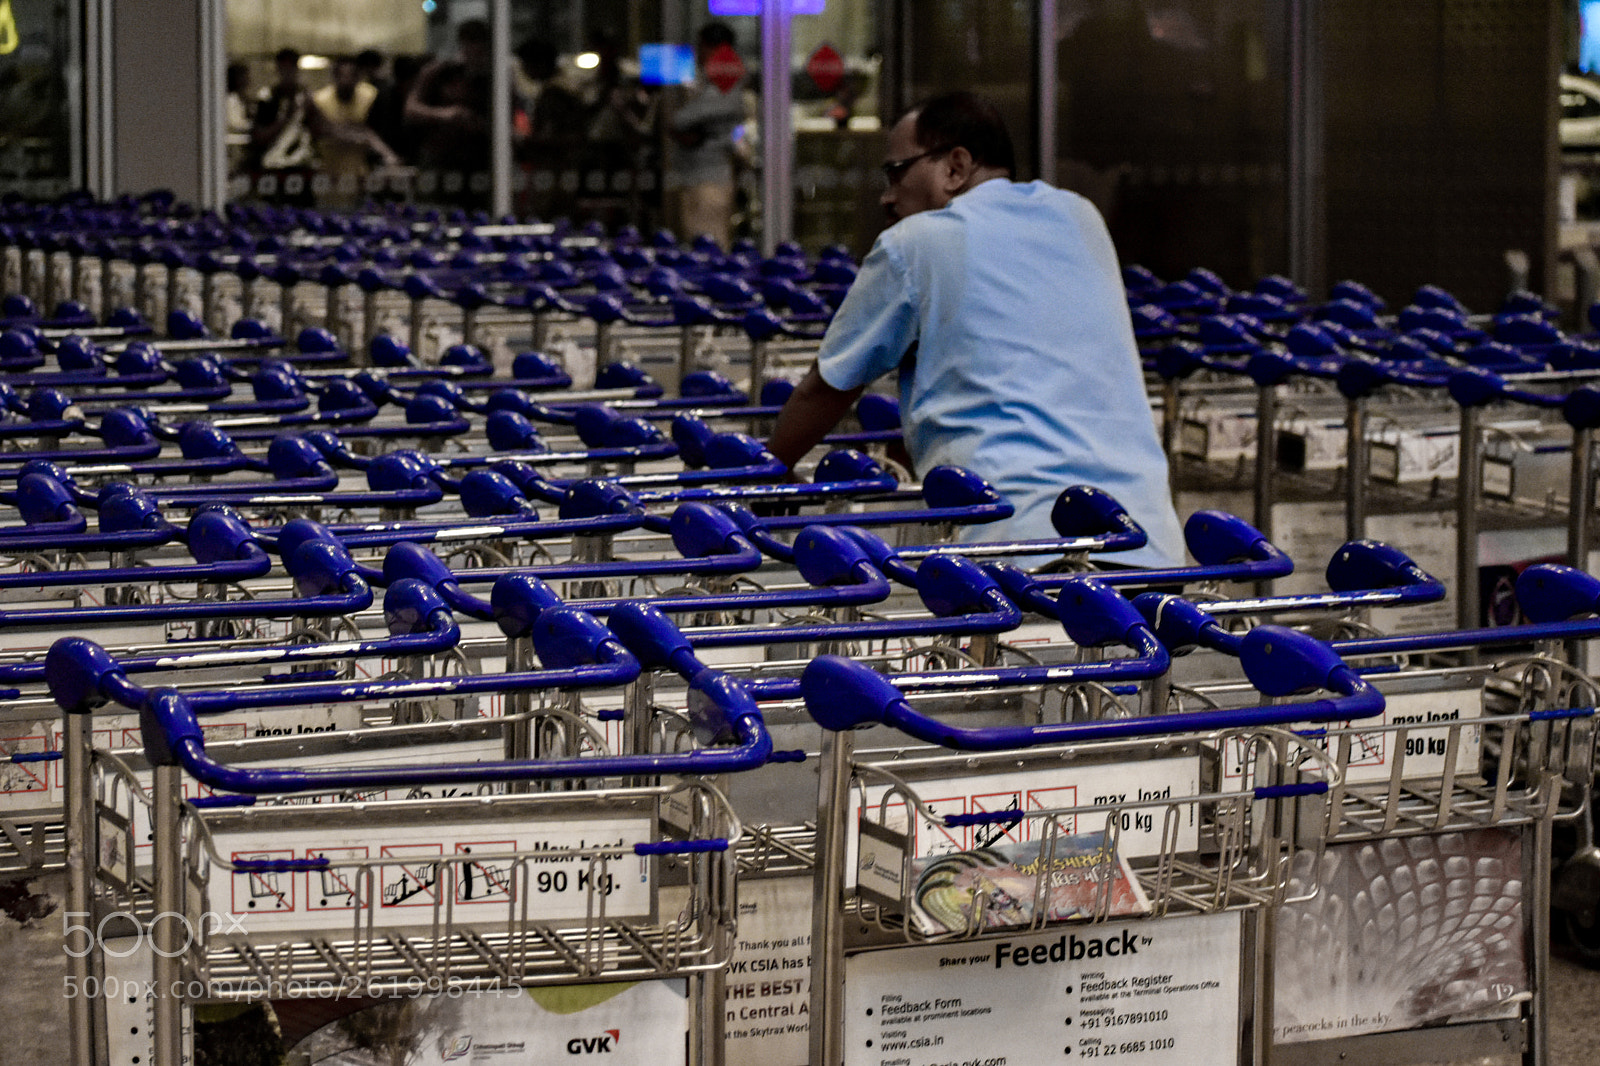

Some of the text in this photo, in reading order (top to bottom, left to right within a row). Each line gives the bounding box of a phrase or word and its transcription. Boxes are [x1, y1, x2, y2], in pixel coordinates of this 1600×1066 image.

[1405, 736, 1445, 756] 90 kg
[1135, 812, 1152, 833] kg
[537, 871, 567, 893] 90
[739, 939, 769, 951] Thank
[771, 938, 789, 950] you
[939, 929, 1153, 968] Share your Feedback by
[751, 958, 779, 972] CSIA
[782, 957, 804, 970] has
[760, 978, 804, 998] BEST
[1080, 974, 1174, 993] Feedback Register
[739, 1002, 794, 1020] Central
[881, 997, 962, 1016] Feedback Form
[1080, 1009, 1168, 1030] +91 9167891010
[1282, 1017, 1334, 1038] peacocks
[1336, 1016, 1348, 1028] in
[1351, 1014, 1369, 1027] the
[750, 1025, 785, 1041] Skytrax
[786, 1023, 811, 1034] Worl
[566, 1037, 612, 1055] GVK
[881, 1035, 944, 1051] www.csia.in
[1079, 1037, 1175, 1058] +91 22 6685 1010
